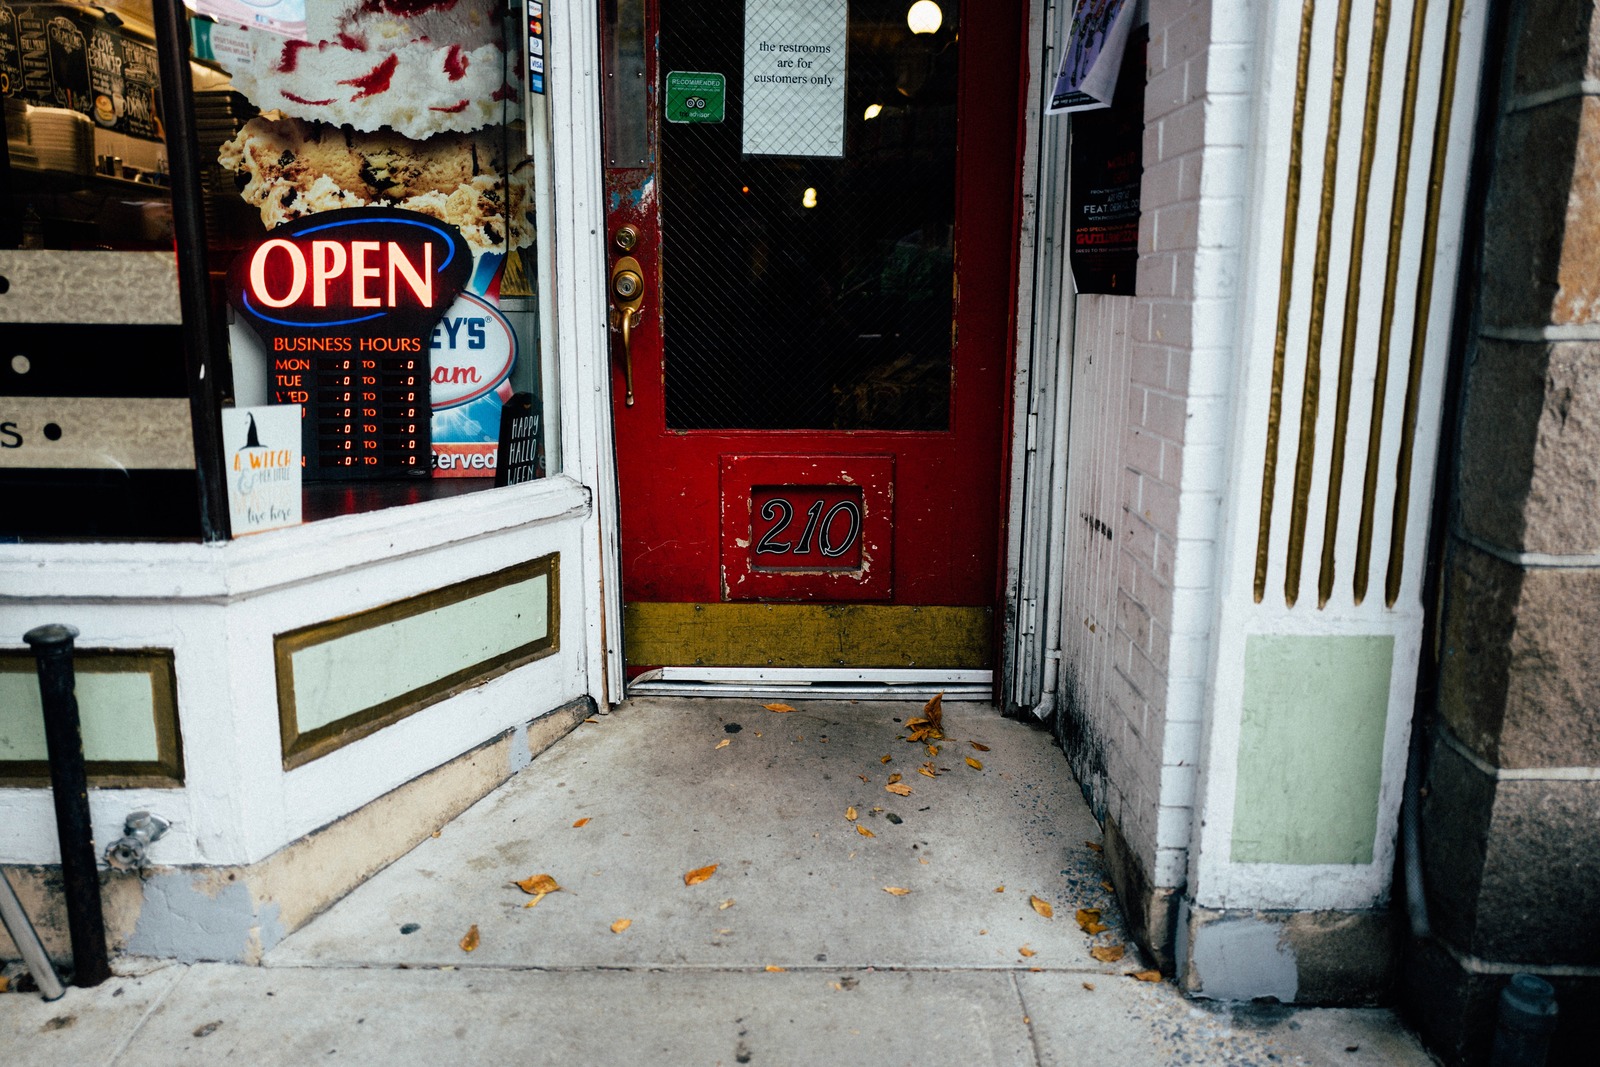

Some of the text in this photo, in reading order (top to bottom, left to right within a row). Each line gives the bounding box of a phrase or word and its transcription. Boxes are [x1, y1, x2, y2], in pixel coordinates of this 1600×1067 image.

[759, 41, 831, 53] the restrooms
[532, 60, 542, 69] VISA
[777, 57, 813, 68] are for
[671, 78, 721, 87] RECOMMENDED
[754, 74, 834, 87] customers only
[679, 111, 709, 119] tripadvisor
[250, 239, 432, 308] OPEN
[274, 337, 421, 351] BUSINESS HOURS
[275, 359, 310, 370] MON
[362, 360, 375, 368] TO
[276, 375, 302, 386] TUE
[362, 376, 375, 384] TO
[363, 392, 376, 400] TO
[363, 408, 376, 416] TO
[363, 424, 377, 432] TO
[511, 414, 539, 440] HAPPY
[364, 440, 377, 448] TO
[509, 438, 537, 466] HALLO
[233, 452, 242, 472] A
[249, 449, 292, 470] WITCH
[364, 456, 377, 465] TO
[507, 464, 535, 486] WEEN
[247, 504, 291, 524] live here
[756, 498, 860, 557] 210
